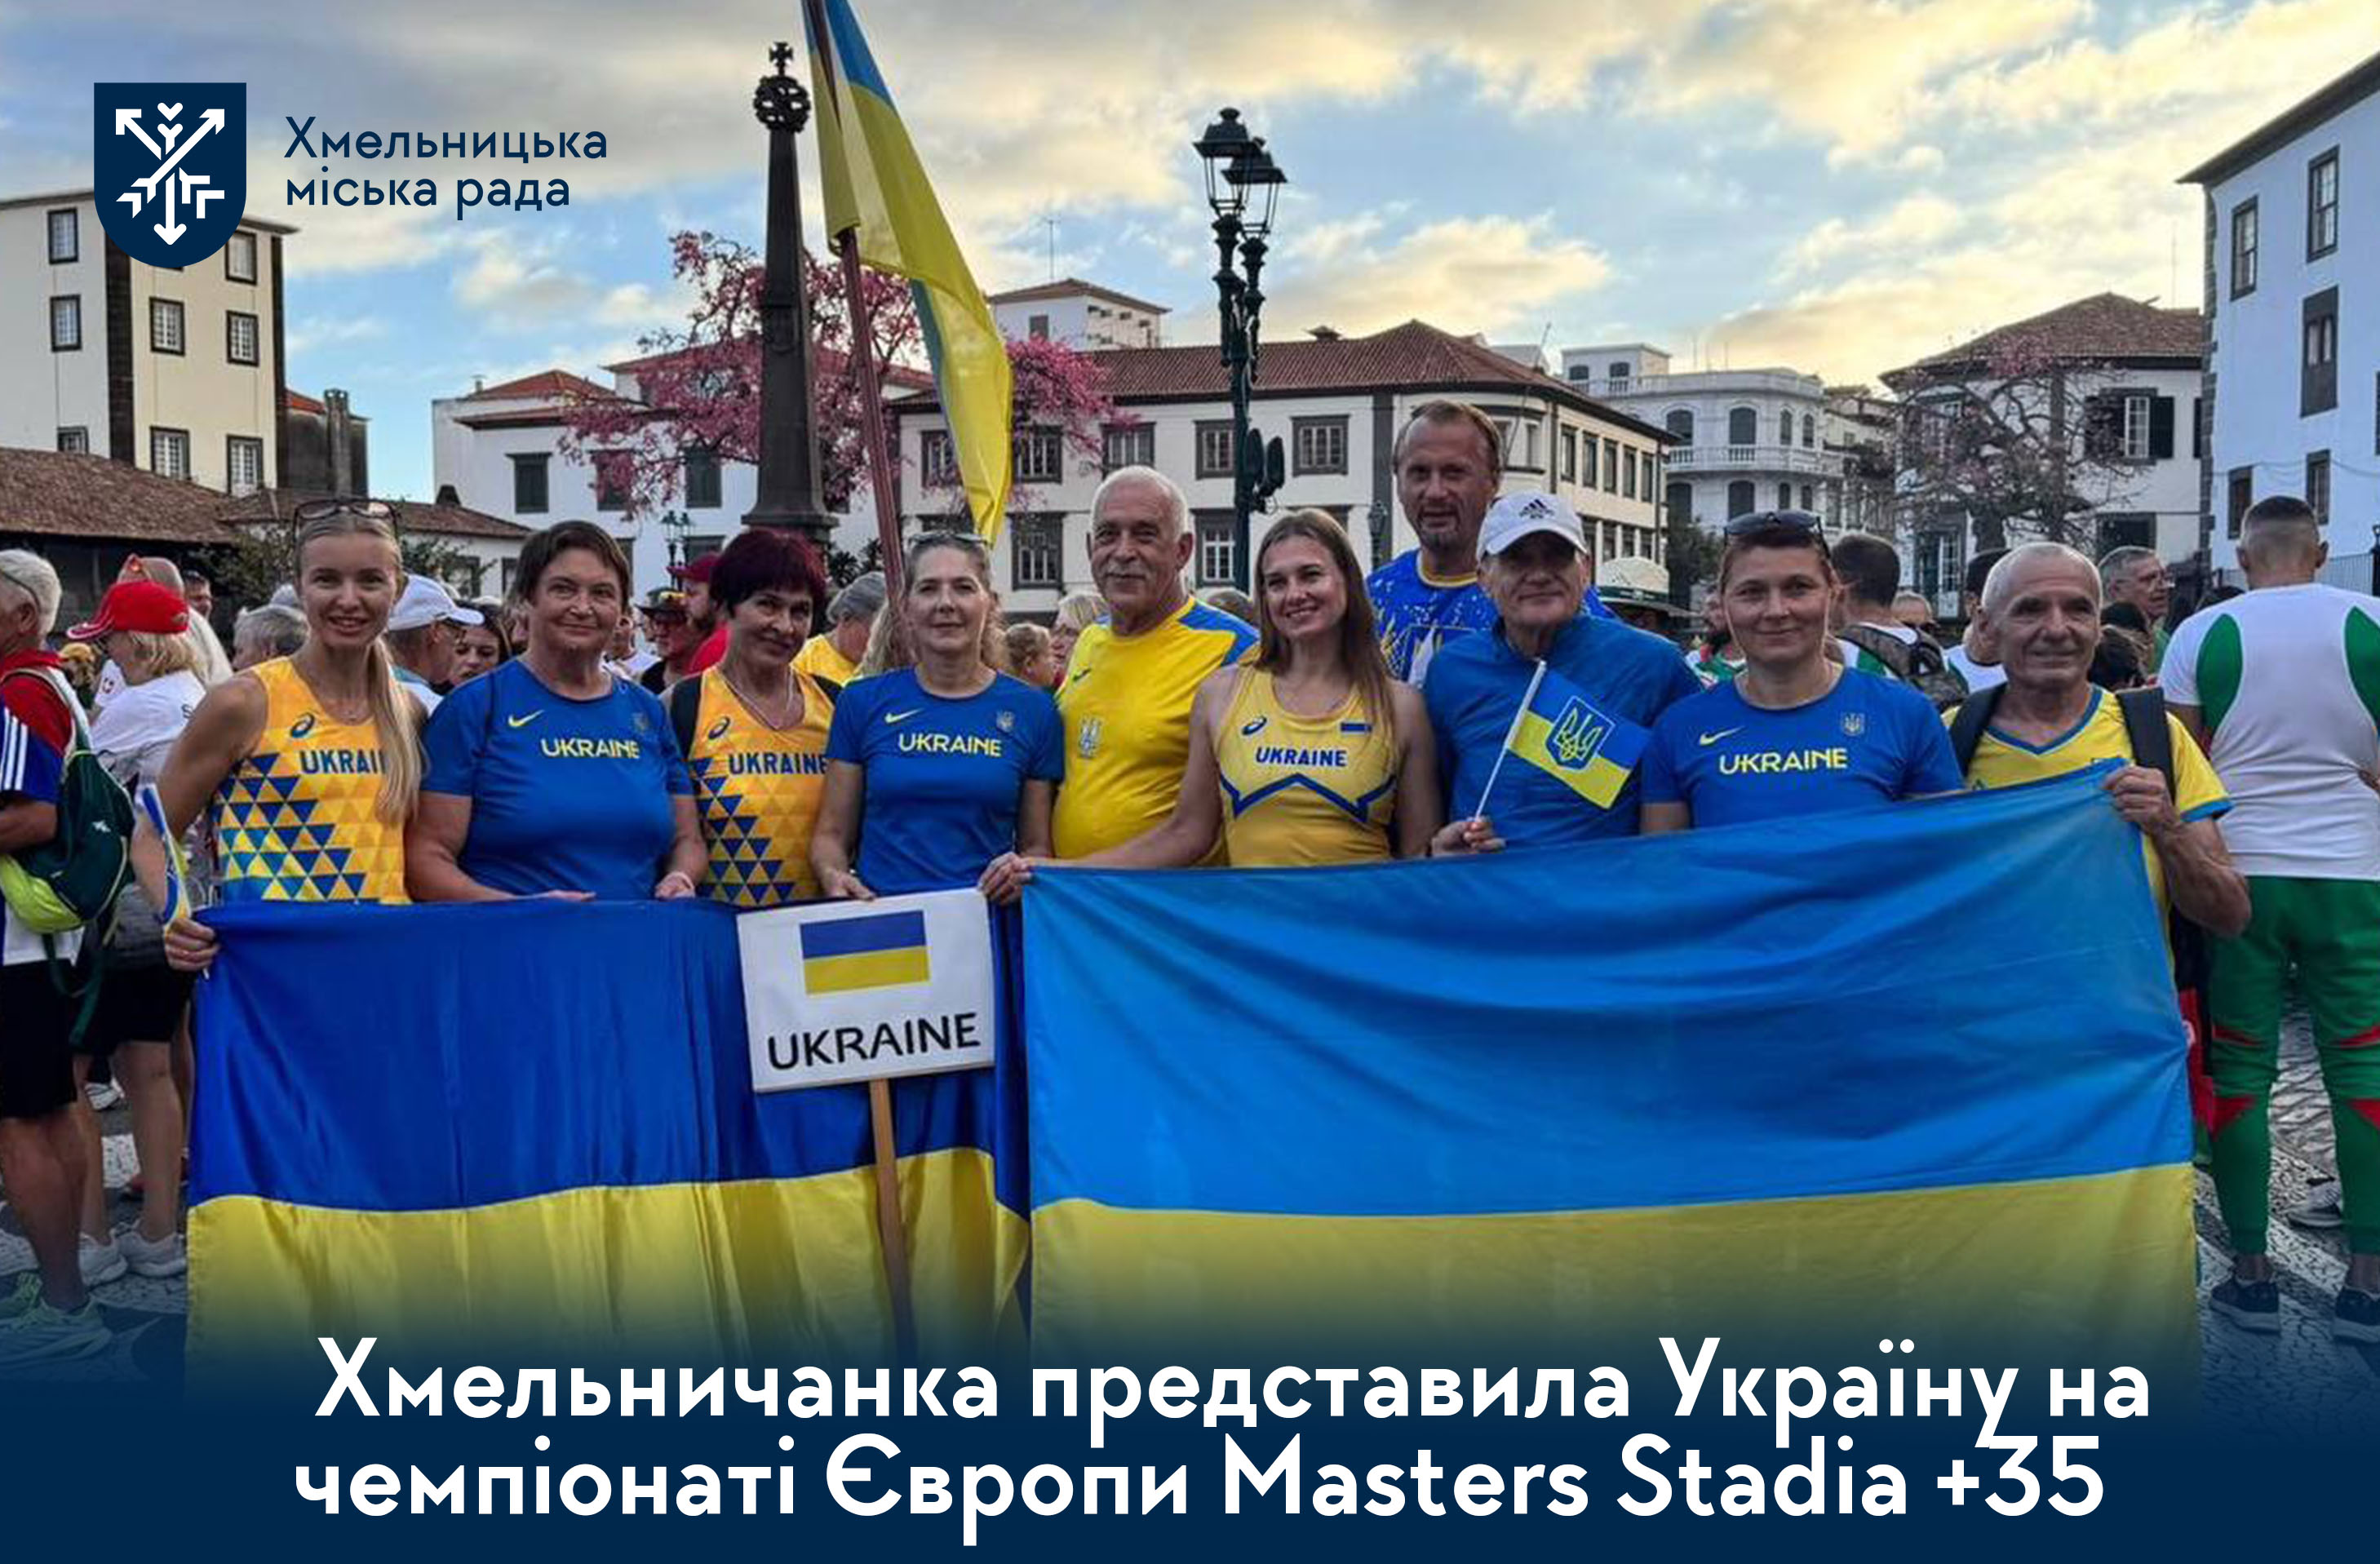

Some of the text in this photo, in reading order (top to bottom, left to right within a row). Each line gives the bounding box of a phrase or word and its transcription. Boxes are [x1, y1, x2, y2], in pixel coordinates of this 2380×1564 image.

[540, 737, 640, 760] UKRAINE
[898, 733, 1002, 758] UKRAINE
[1256, 747, 1348, 767] UKRAINE
[299, 749, 387, 774] UKRAI
[1718, 746, 1848, 775] UKRAINE
[768, 1012, 981, 1070] UKRAINE
